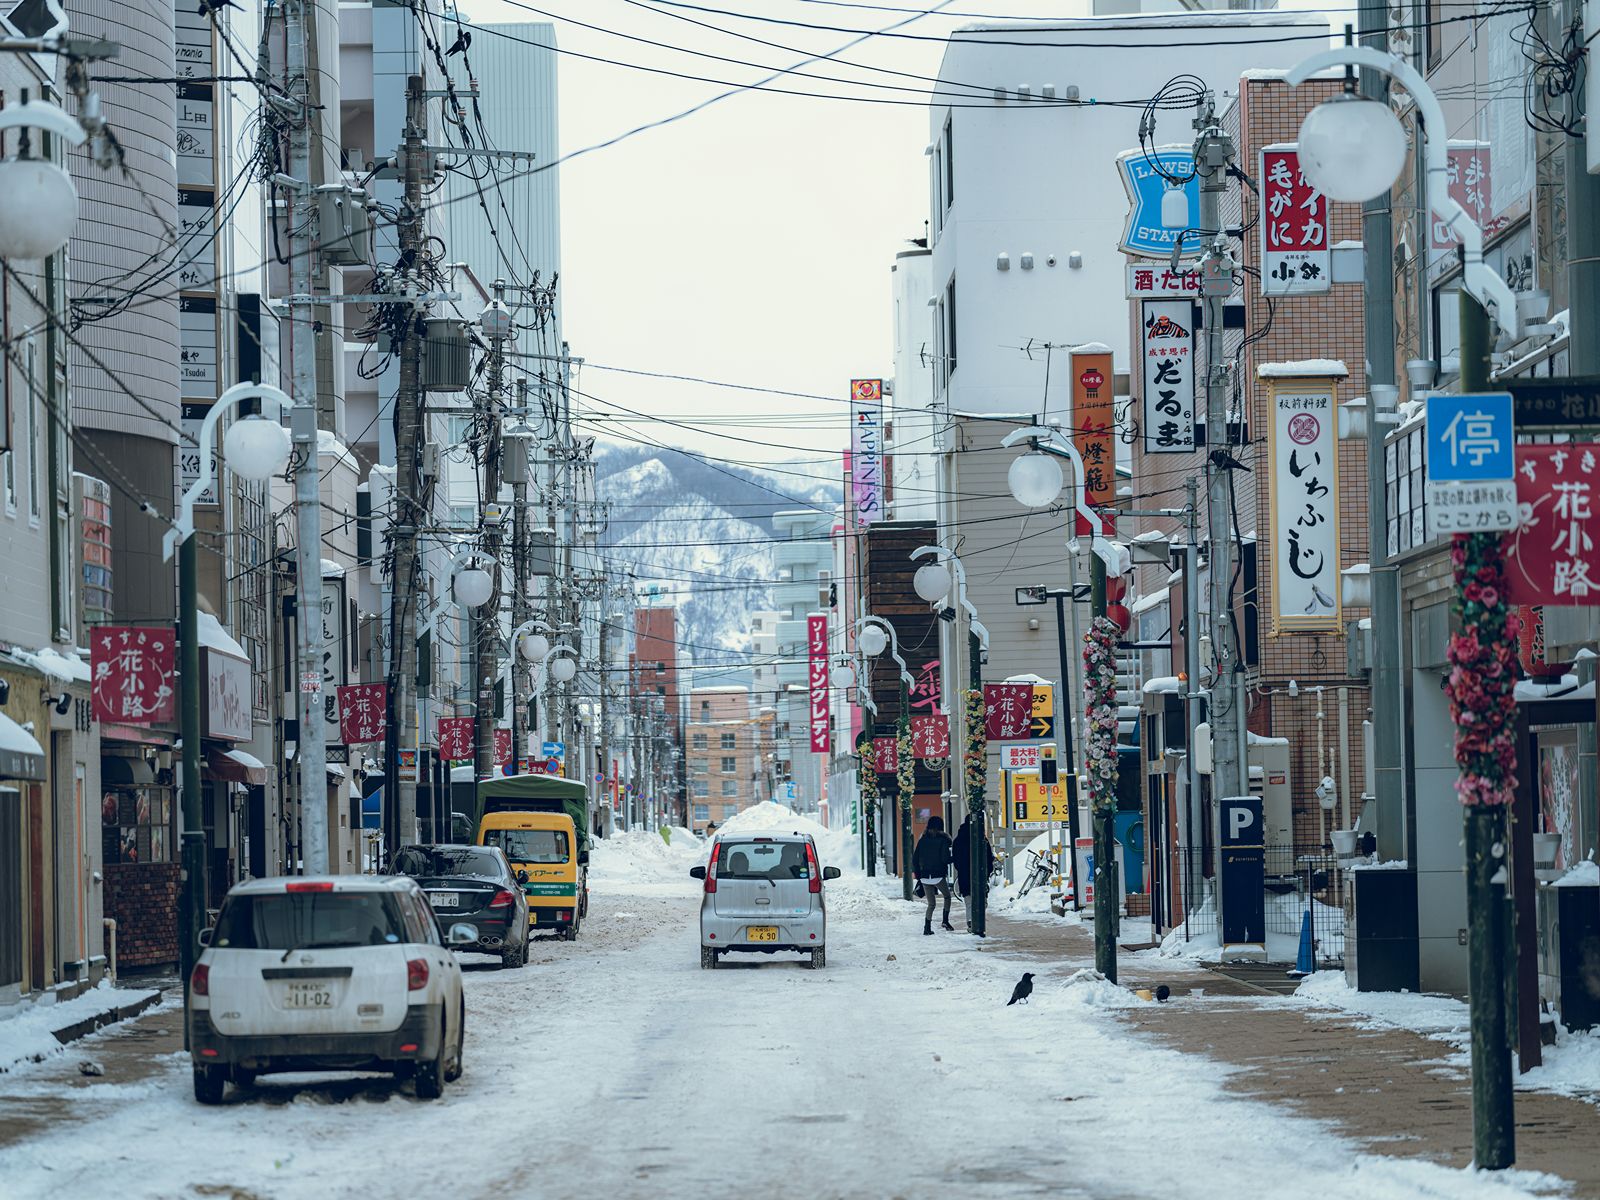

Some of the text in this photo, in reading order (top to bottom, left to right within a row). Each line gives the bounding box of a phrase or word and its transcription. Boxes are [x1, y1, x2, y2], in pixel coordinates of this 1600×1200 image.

[178, 105, 207, 123] 上田
[1268, 159, 1294, 247] 毛がに
[184, 368, 206, 377] Tsudoi
[1153, 358, 1182, 447] だるま
[1279, 397, 1328, 410] 板前料理
[1440, 409, 1500, 467] 停
[857, 410, 878, 514] HAPPINESS
[1288, 448, 1329, 579] いちふじ
[1437, 510, 1512, 528] ここから
[1551, 481, 1594, 596] 花小路
[101, 631, 164, 652] すすきの
[120, 649, 145, 717] 花小路
[990, 687, 1027, 699] すすきの
[811, 656, 828, 748] ヤングレディ
[1000, 698, 1015, 737] 花小路
[355, 698, 373, 740] 花小路
[451, 728, 463, 758] 花小路
[923, 725, 936, 756] 花小路
[1010, 748, 1039, 757] 最大料
[1040, 785, 1059, 795] 80
[1229, 807, 1254, 839] P
